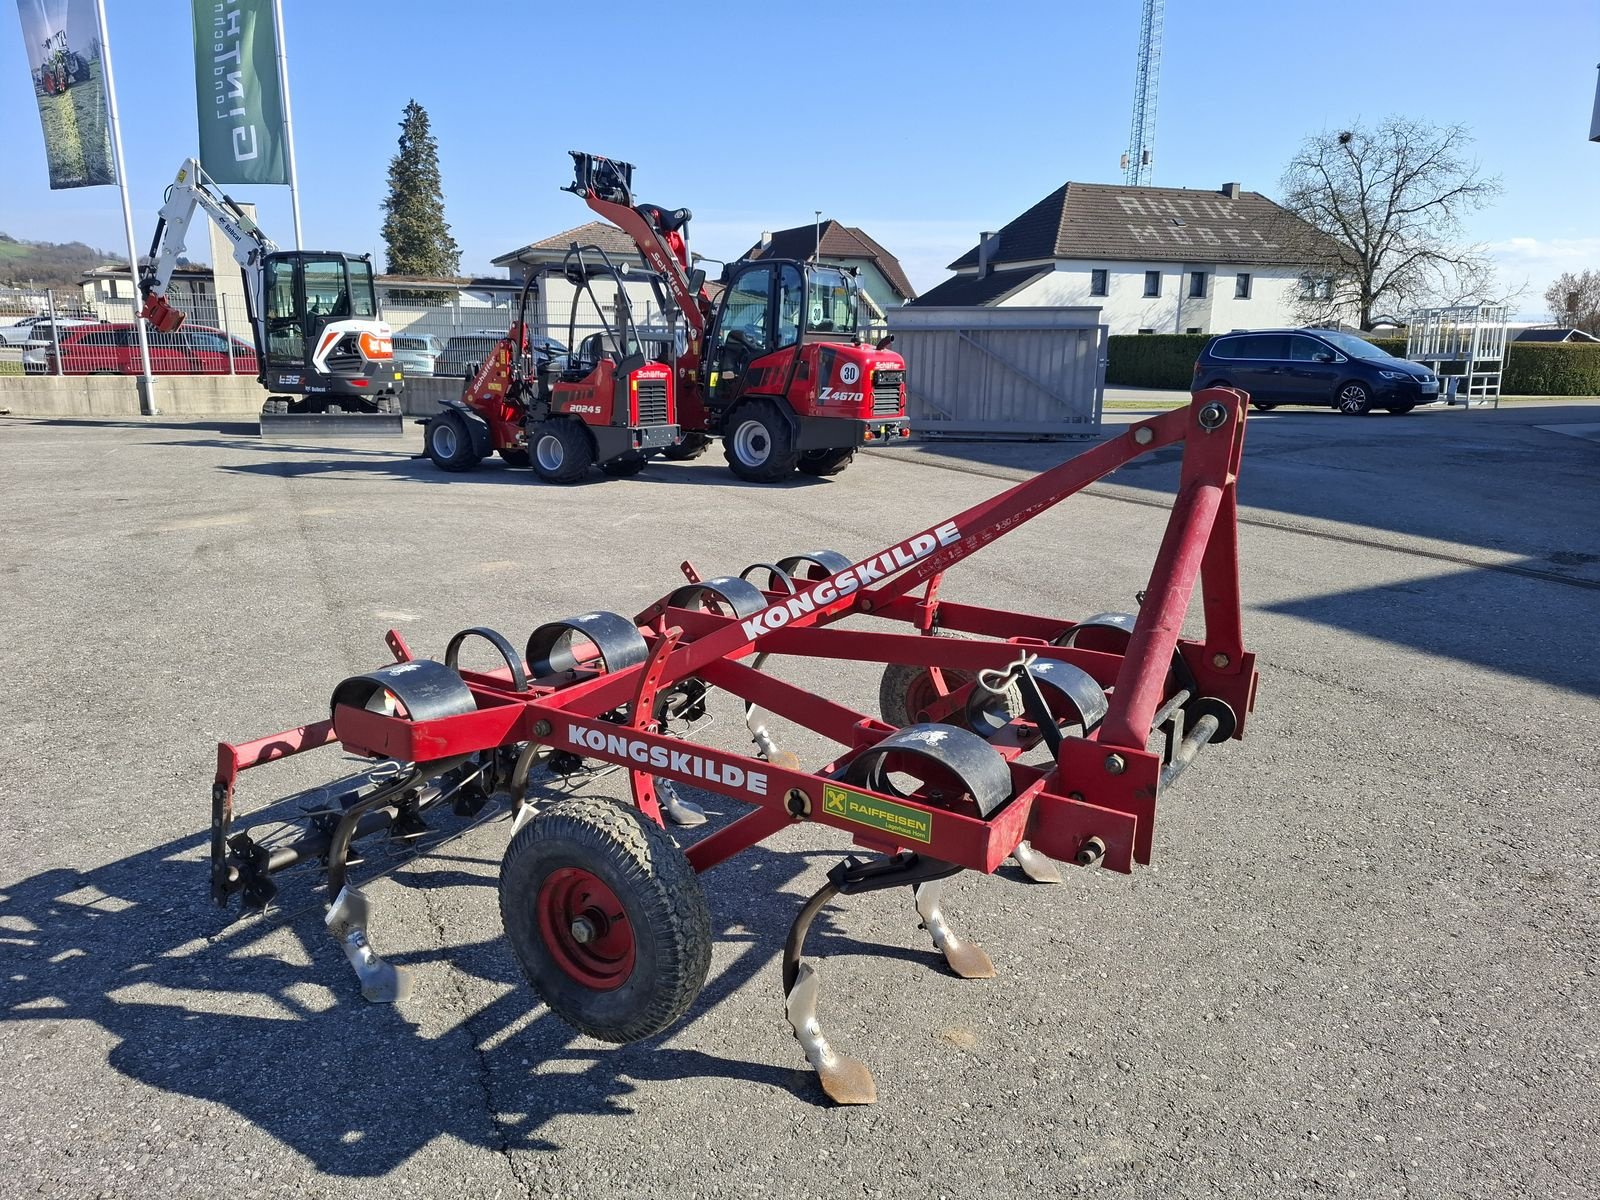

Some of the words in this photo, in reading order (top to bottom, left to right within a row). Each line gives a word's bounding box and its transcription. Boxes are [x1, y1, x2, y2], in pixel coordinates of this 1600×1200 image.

[1115, 196, 1246, 220] ANTIK
[224, 223, 242, 242] Bobcat
[473, 356, 496, 393] Schäffer
[636, 370, 667, 378] Schäffer
[844, 367, 856, 380] 30
[875, 361, 901, 369] Schäffer
[741, 521, 961, 640] KONGSKILDE
[569, 724, 767, 796] KONGSKILDE
[849, 802, 926, 831] RAIFFEISEN
[885, 822, 912, 834] Lagerhaus
